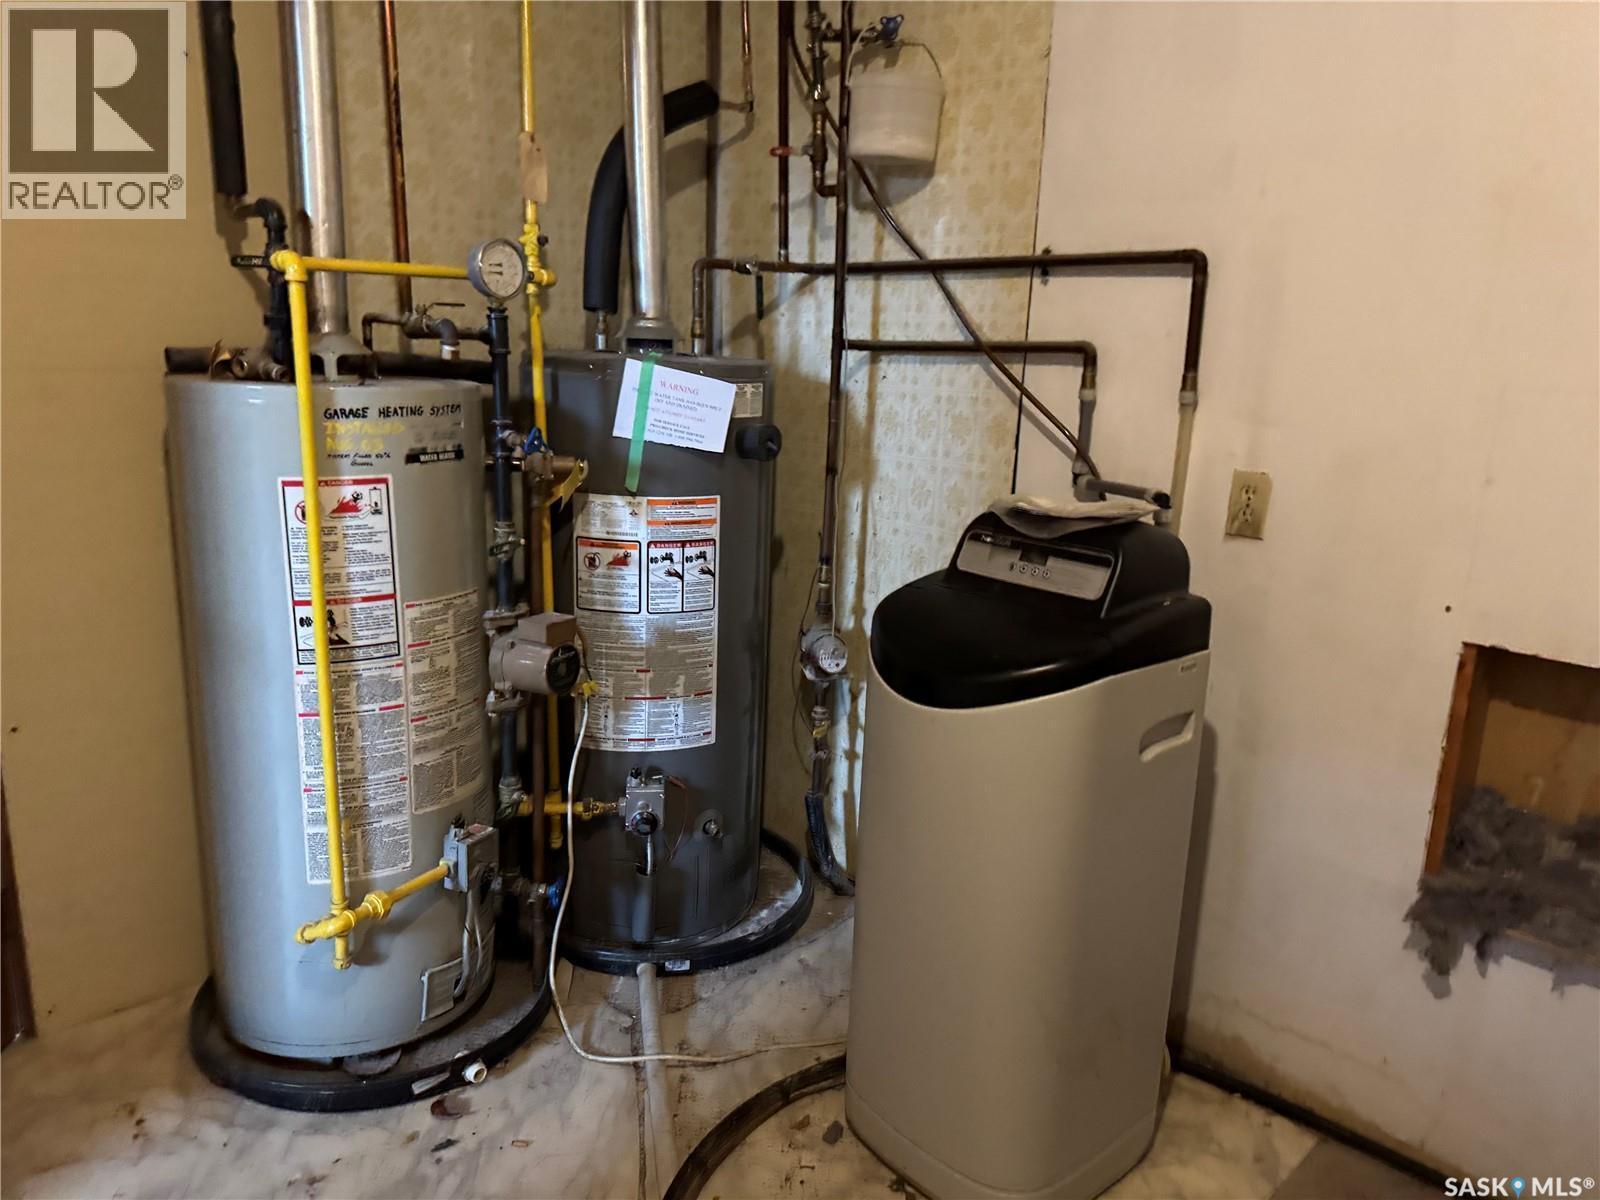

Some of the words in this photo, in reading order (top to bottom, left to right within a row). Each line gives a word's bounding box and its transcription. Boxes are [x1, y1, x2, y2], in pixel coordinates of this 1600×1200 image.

[660, 380, 699, 396] WARNING
[323, 407, 369, 420] GARAGE
[378, 405, 424, 419] HEATING
[429, 403, 462, 417] SYSTEM
